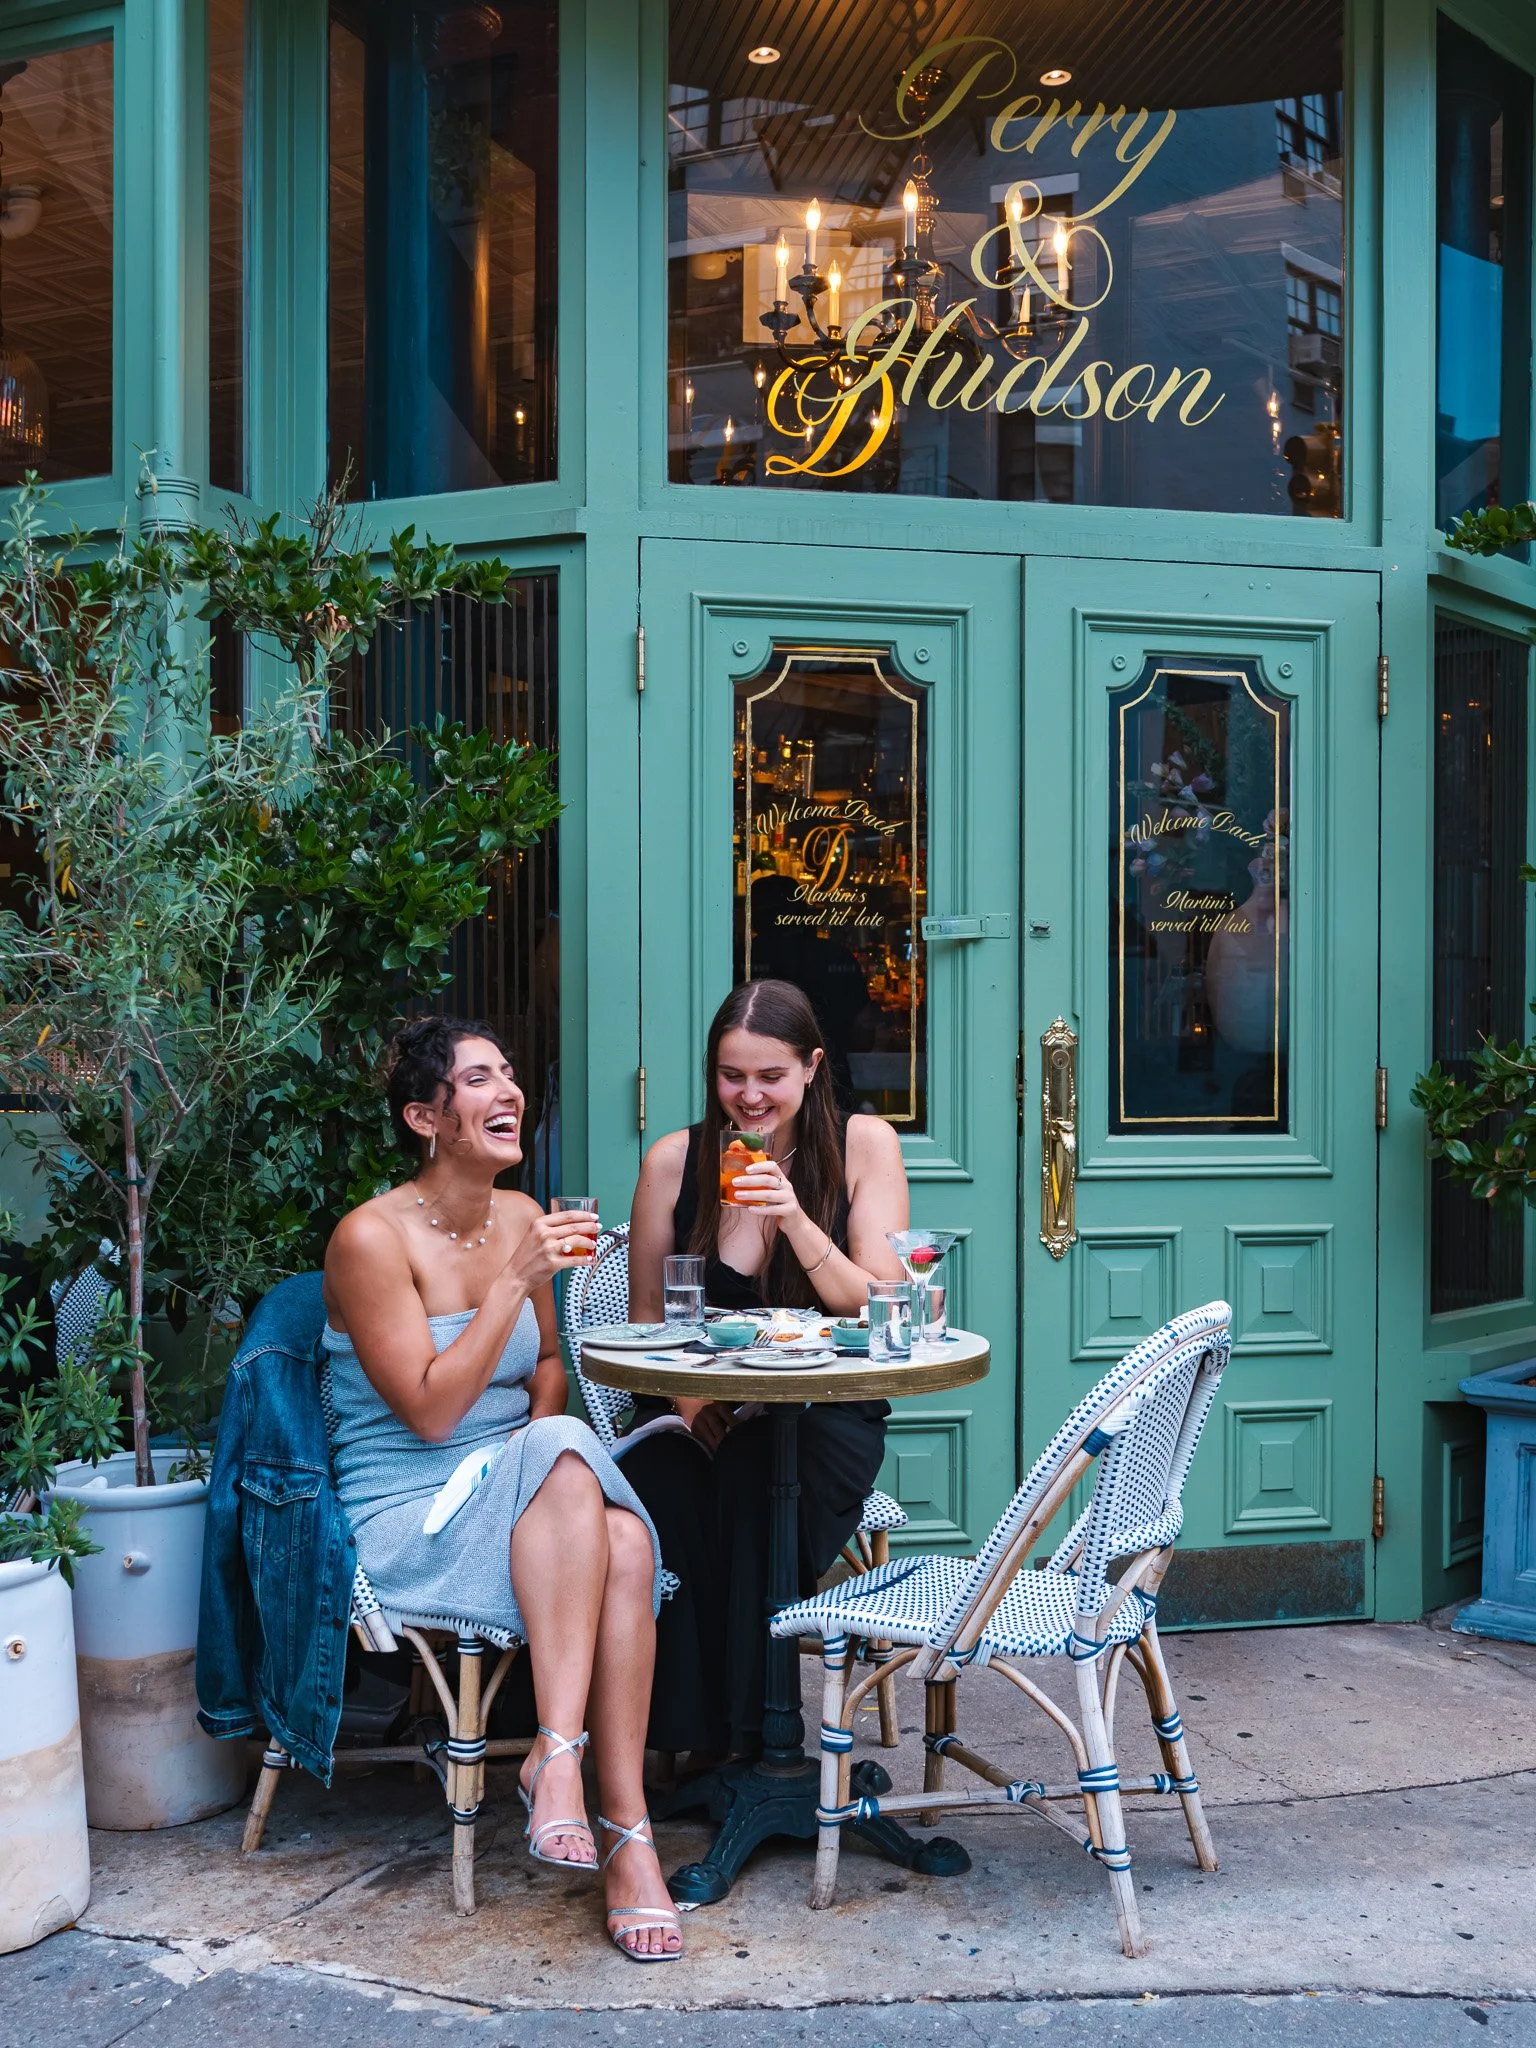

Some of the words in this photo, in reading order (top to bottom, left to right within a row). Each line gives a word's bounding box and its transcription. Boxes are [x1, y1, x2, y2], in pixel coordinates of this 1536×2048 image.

[858, 36, 1177, 222] Perry
[971, 181, 1113, 311] &
[795, 298, 1226, 427] Hudson
[766, 355, 913, 477] D
[757, 797, 840, 835] Welcome
[842, 799, 904, 837] Back
[1130, 808, 1208, 845] Welcome
[1210, 811, 1267, 848] Back
[774, 908, 828, 926] served
[853, 906, 885, 926] late
[1160, 890, 1235, 913] Martini's
[1149, 915, 1199, 932] served
[1199, 913, 1226, 932] 'till
[1222, 913, 1252, 933] late
